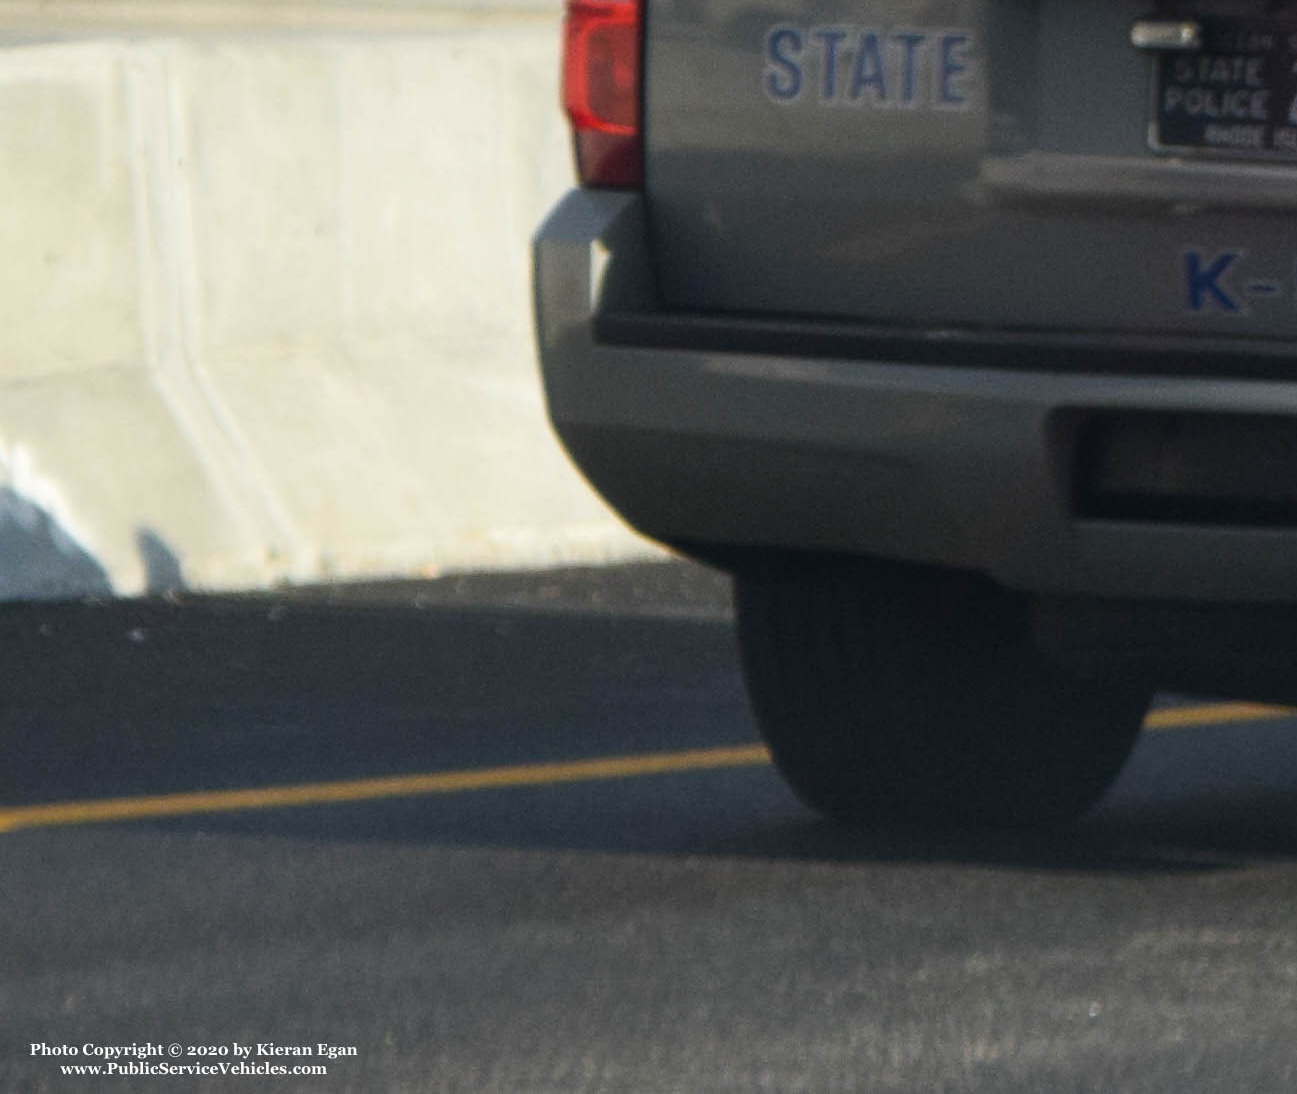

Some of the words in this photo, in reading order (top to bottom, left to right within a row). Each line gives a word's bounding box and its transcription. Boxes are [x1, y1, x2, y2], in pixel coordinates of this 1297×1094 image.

[766, 27, 968, 104] STATE
[1173, 57, 1266, 86] STATE
[1164, 88, 1272, 120] POLICE
